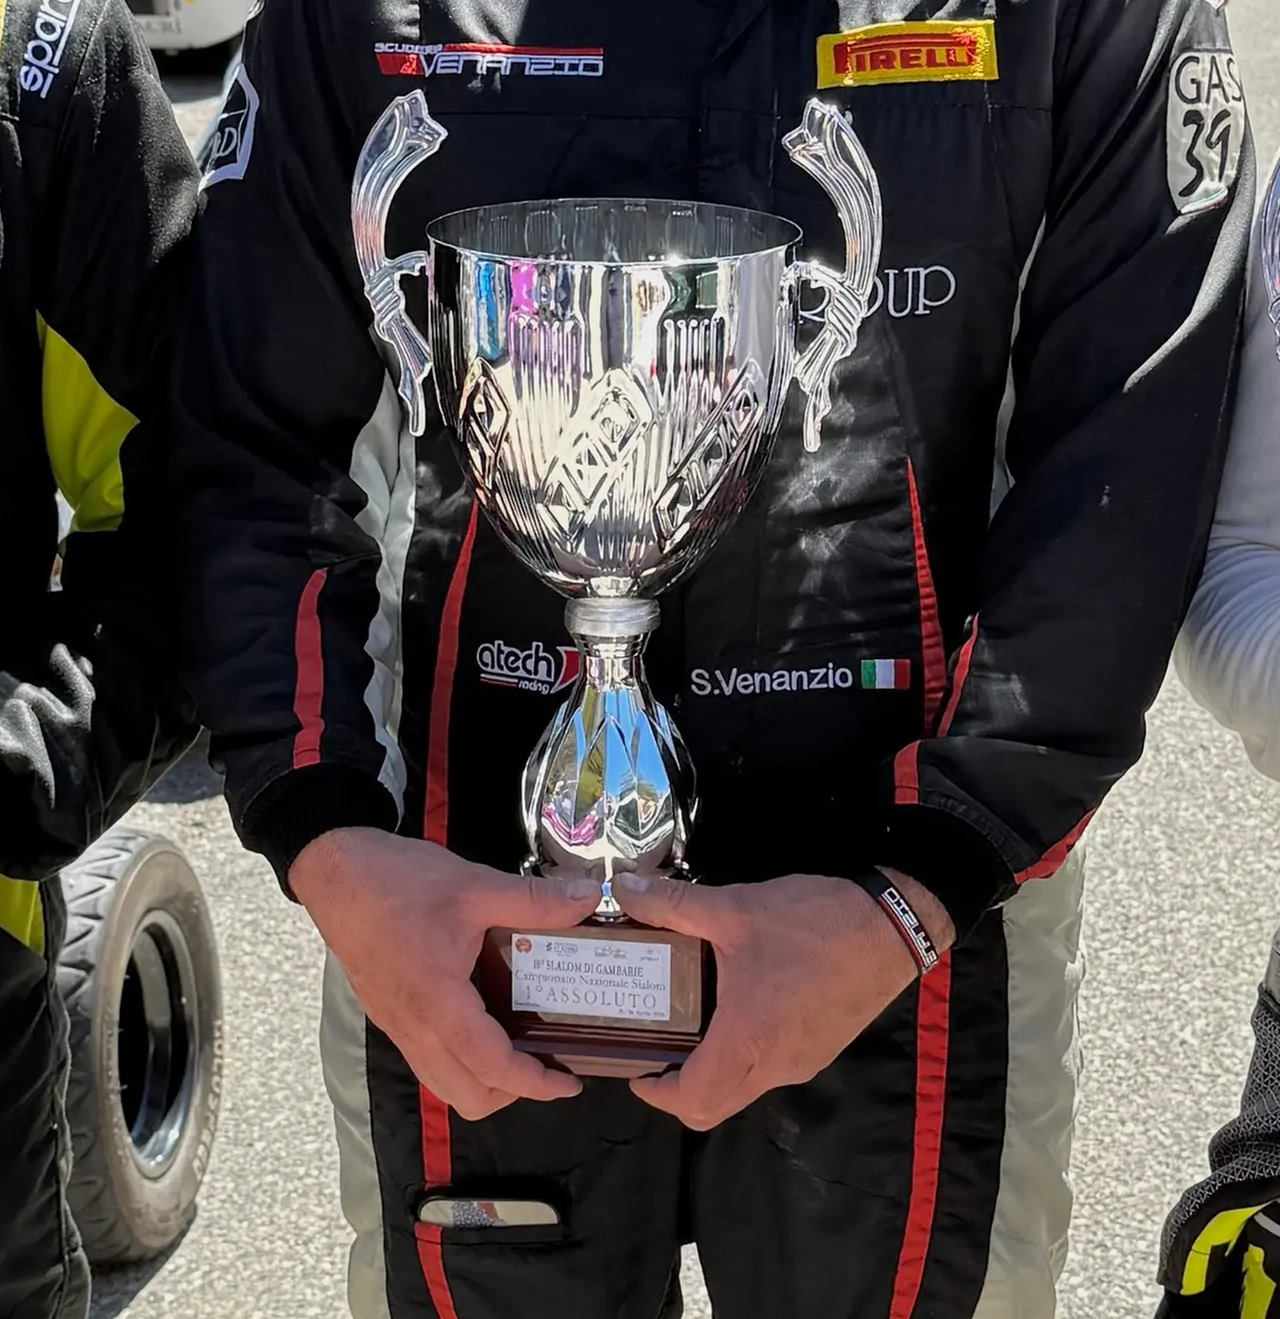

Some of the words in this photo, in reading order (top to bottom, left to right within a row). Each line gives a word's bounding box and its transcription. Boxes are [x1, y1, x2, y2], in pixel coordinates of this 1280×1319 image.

[420, 52, 604, 78] VENANZIO
[832, 32, 980, 74] PIRELLI
[1174, 54, 1243, 105] GAS
[1177, 108, 1232, 198] 39
[476, 640, 555, 682] atech
[690, 662, 854, 696] S.Venanzio
[584, 963, 594, 975] DI
[546, 987, 657, 1010] ASSOLUTO
